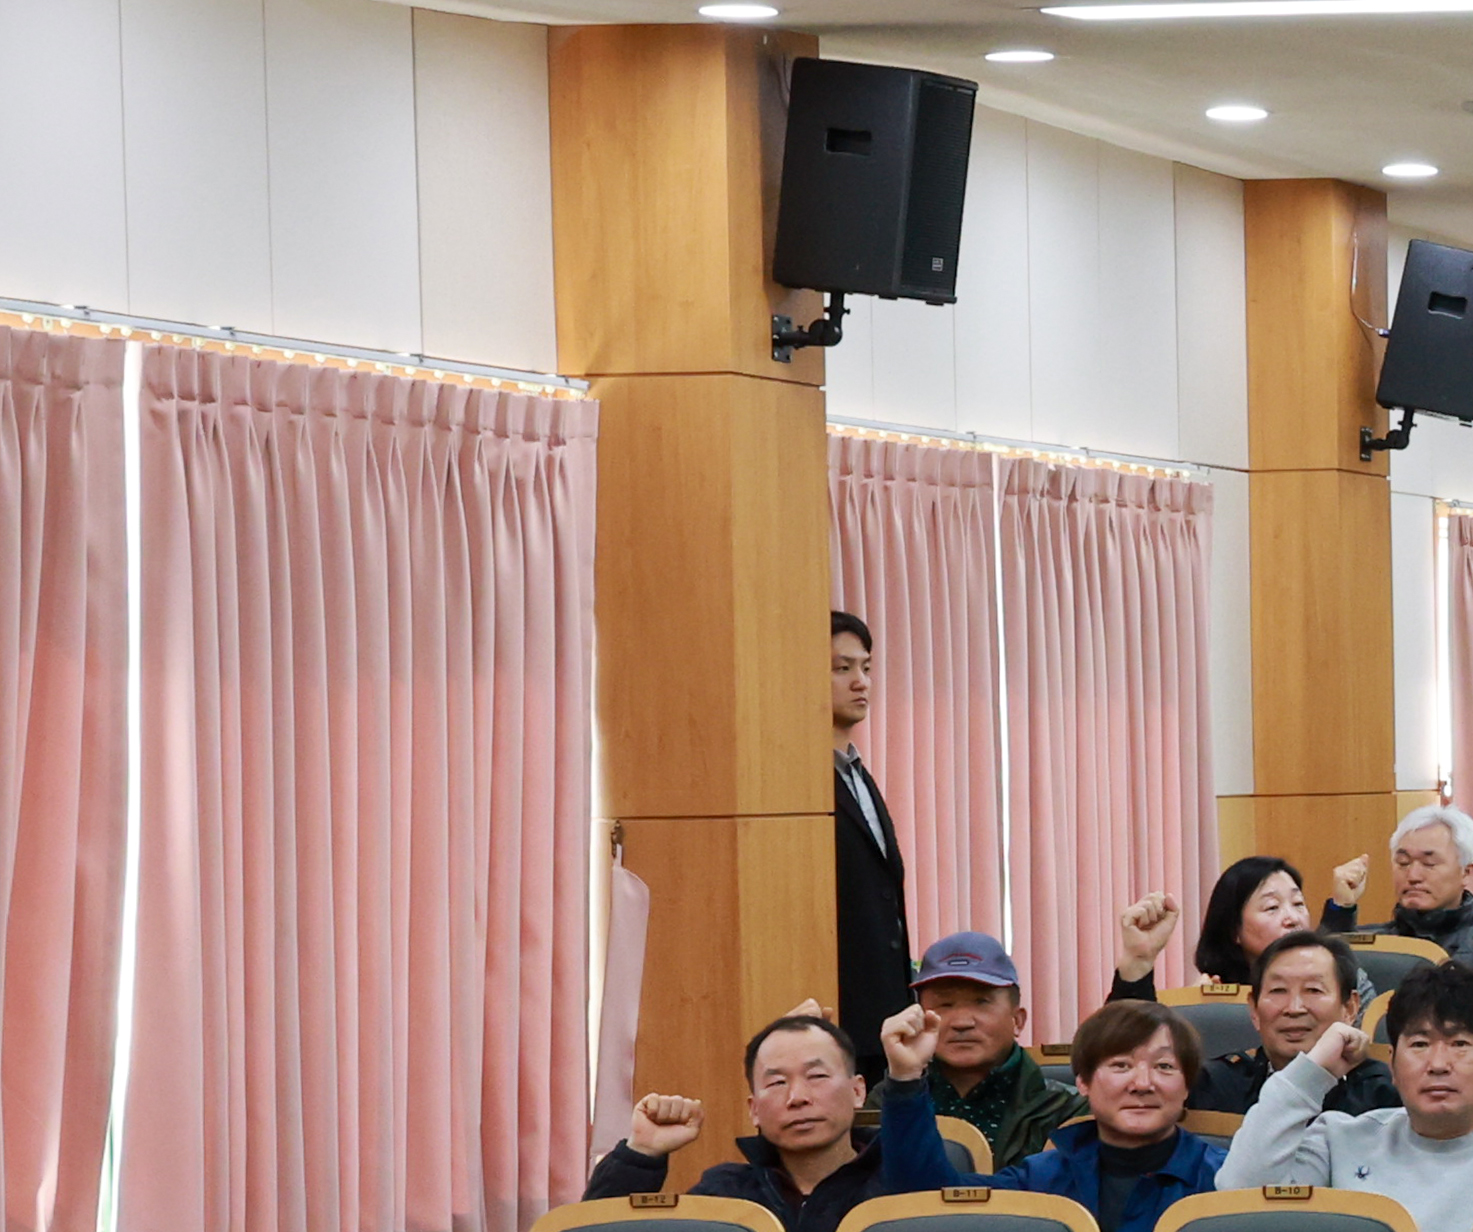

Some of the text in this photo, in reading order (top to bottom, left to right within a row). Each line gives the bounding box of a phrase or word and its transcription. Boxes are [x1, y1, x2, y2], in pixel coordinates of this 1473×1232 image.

[952, 1188, 979, 1199] B-11
[1273, 1186, 1301, 1196] B-10
[640, 1194, 667, 1204] B-12
